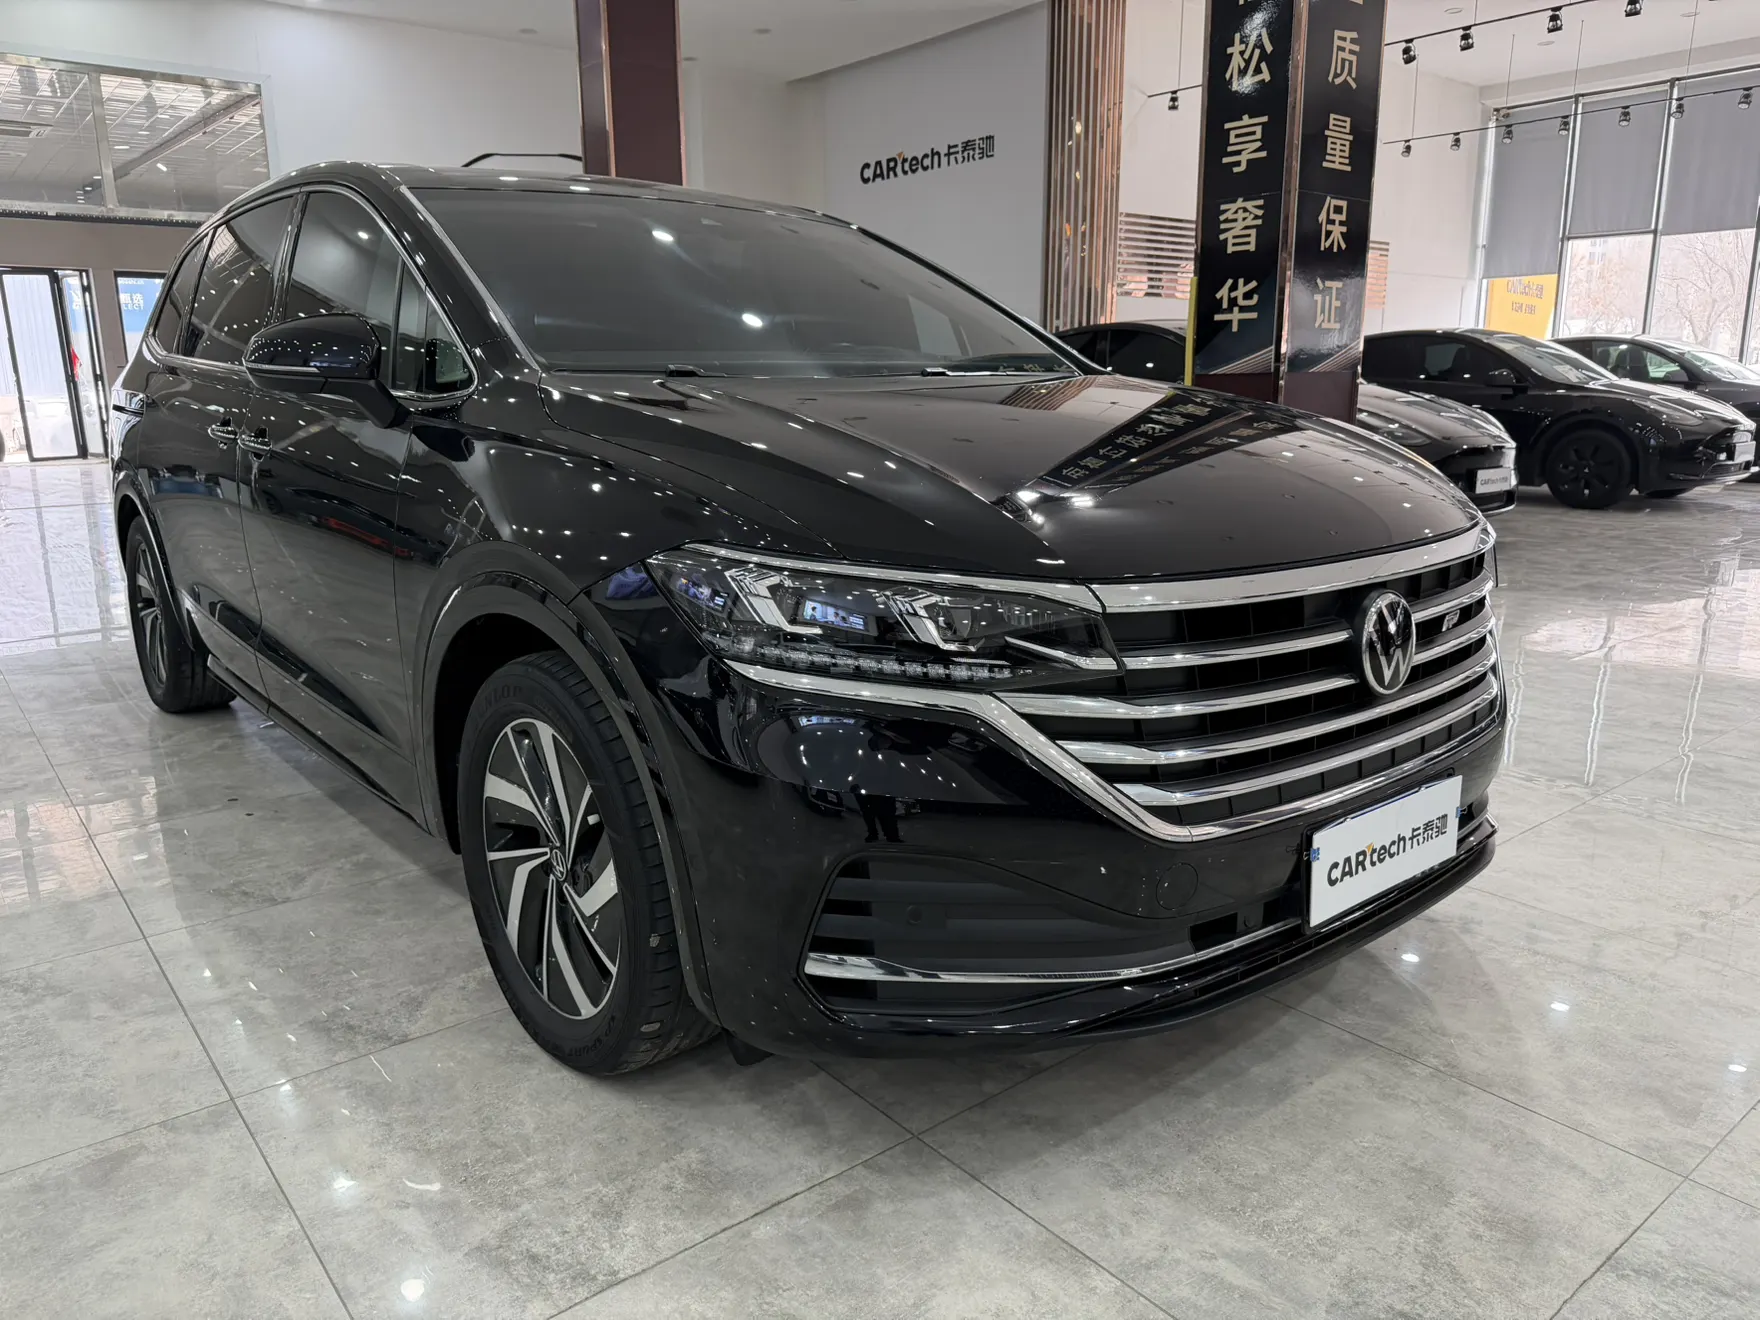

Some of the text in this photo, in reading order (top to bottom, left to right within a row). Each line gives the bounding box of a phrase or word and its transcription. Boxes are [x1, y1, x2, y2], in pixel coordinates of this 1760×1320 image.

[860, 147, 941, 184] CARtech
[1213, 0, 1274, 332] 松享奢华
[1313, 0, 1364, 329] 质量保证
[1327, 813, 1448, 887] CARtech 卡泰驰
